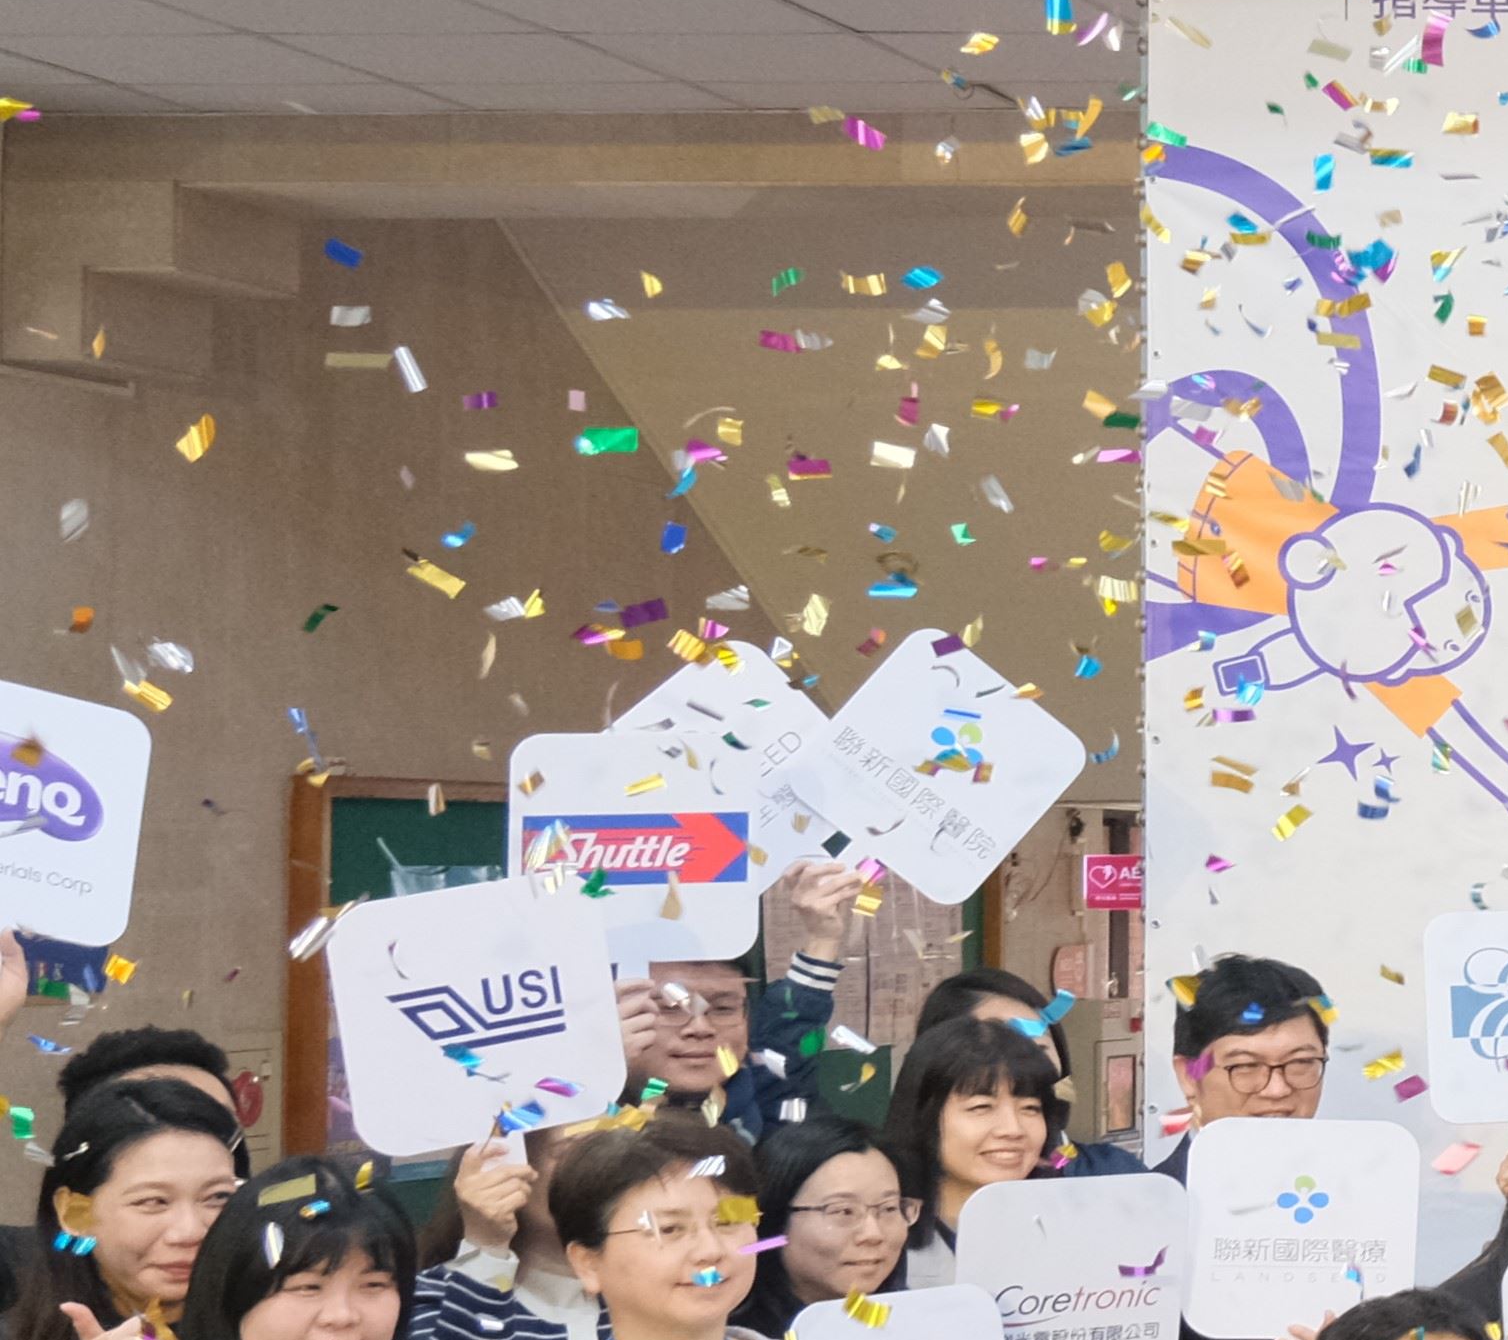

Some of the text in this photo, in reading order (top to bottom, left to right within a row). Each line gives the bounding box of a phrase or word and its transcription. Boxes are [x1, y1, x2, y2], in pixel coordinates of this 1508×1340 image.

[0, 769, 87, 827] nQ
[832, 725, 997, 861] 聯新國際醫院
[548, 831, 691, 873] Shuttle
[46, 871, 93, 897] Corp
[480, 965, 563, 1016] USI
[1213, 1237, 1388, 1264] 聯新國際醫療
[996, 1267, 1162, 1321] Coretronic
[1210, 1271, 1387, 1284] LANDSED
